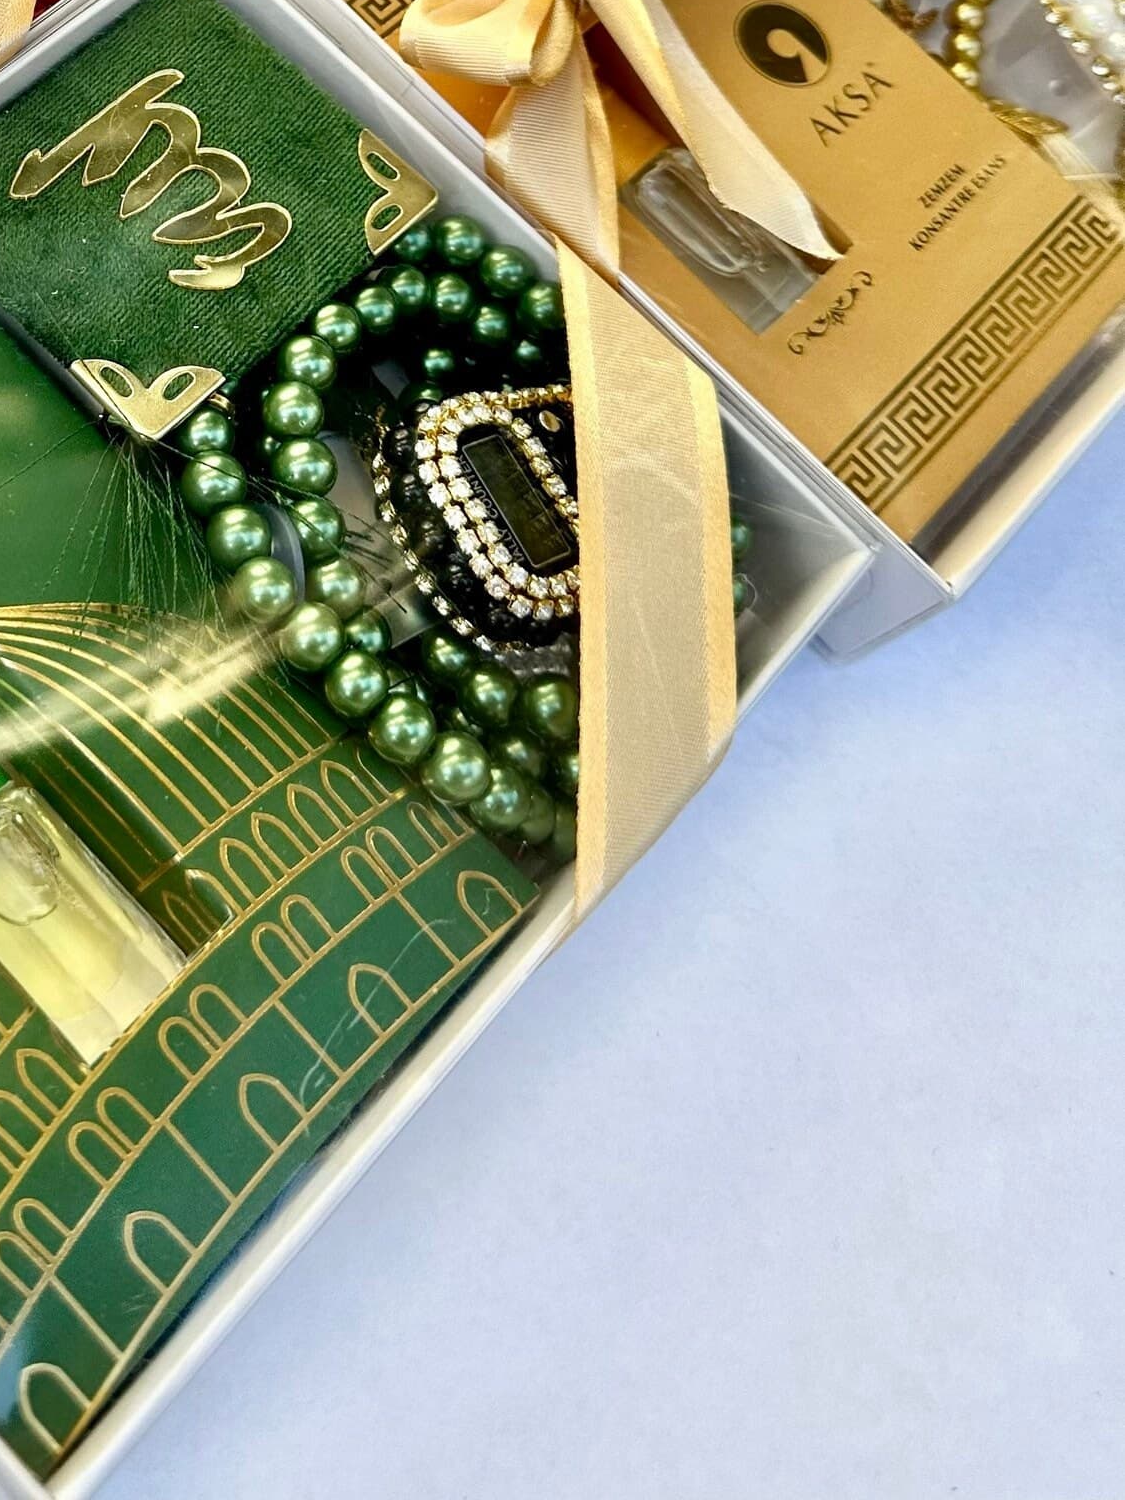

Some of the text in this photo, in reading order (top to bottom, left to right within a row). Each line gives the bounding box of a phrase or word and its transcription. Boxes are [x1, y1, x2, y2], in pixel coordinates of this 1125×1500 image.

[810, 70, 894, 149] AKSA
[908, 154, 1006, 252] KONSANTRE ESANS
[916, 162, 967, 209] ZEMZEM
